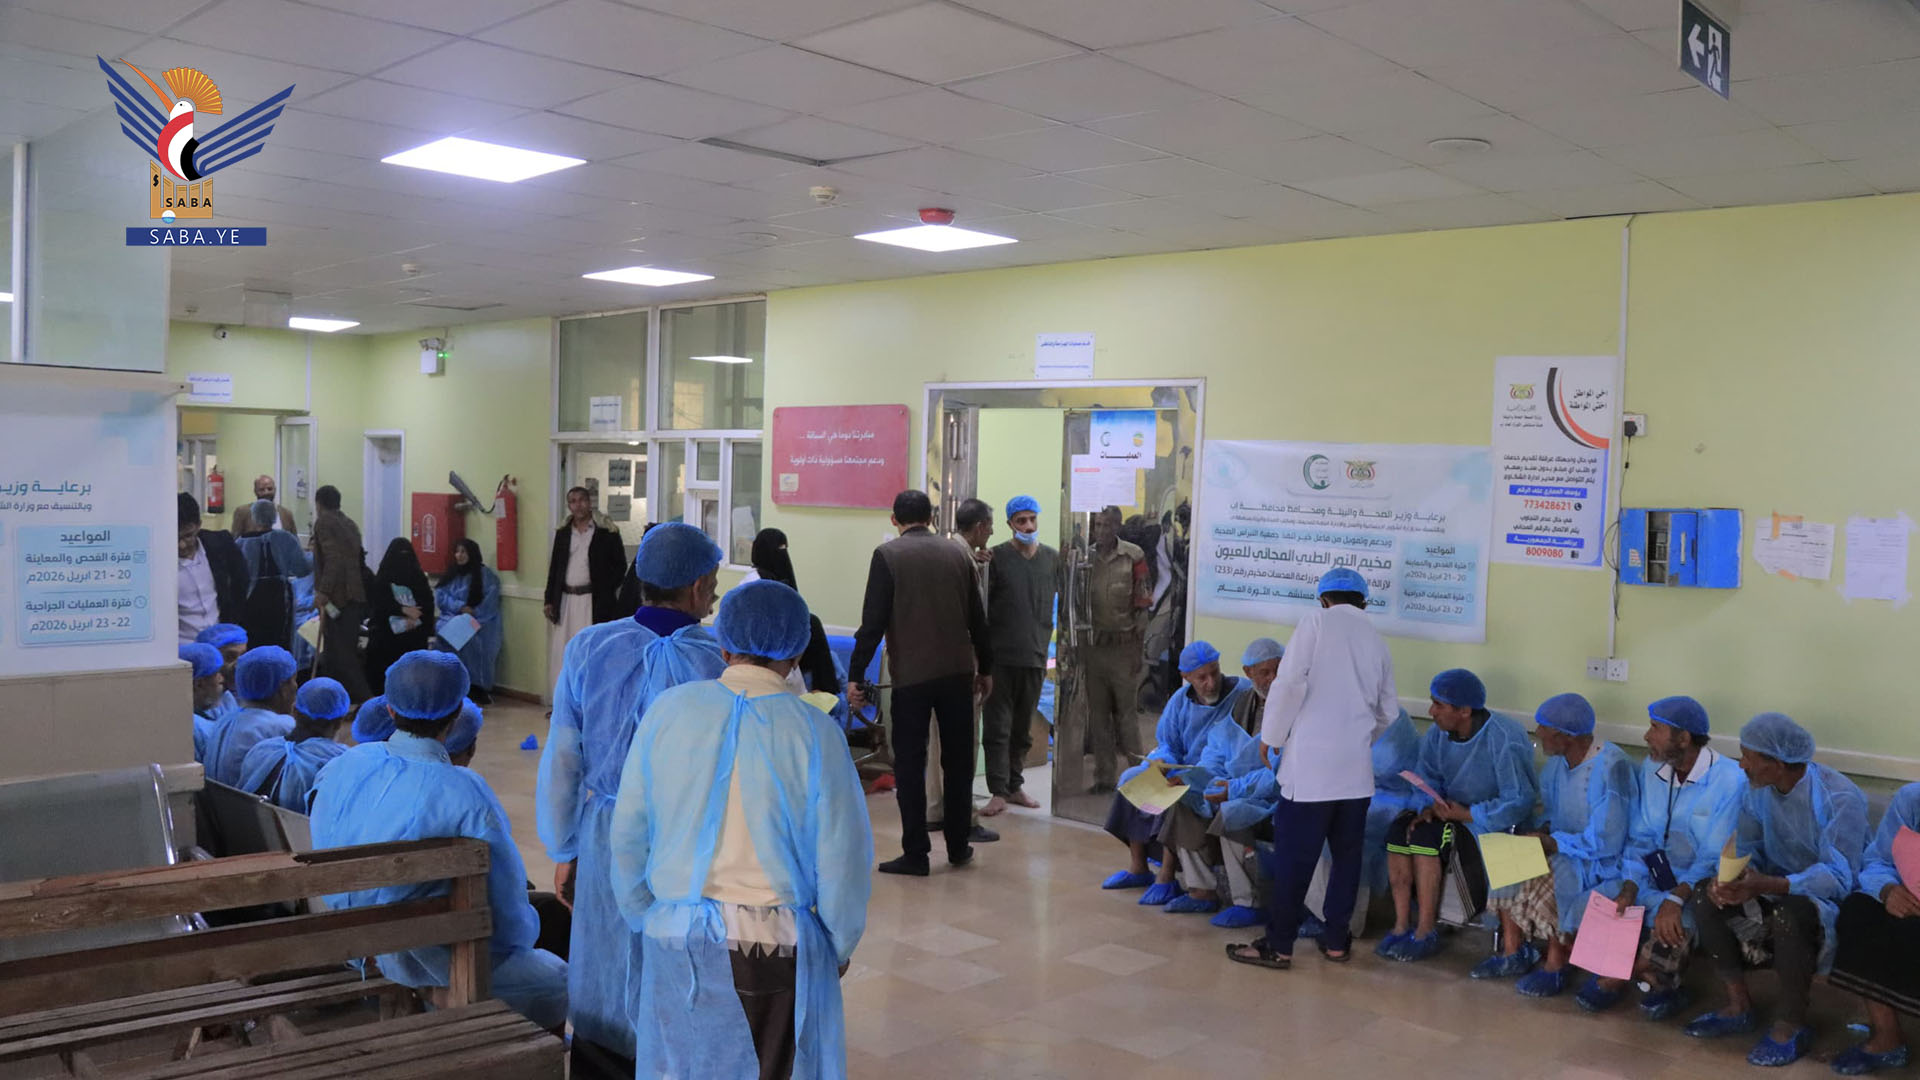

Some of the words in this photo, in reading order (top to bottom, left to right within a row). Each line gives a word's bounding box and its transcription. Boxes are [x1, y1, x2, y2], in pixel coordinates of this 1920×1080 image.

[1523, 499, 1571, 511] 773428621
[60, 530, 111, 545] المواعيد
[25, 552, 73, 566] والمعاينة
[75, 551, 108, 565] الفحص
[110, 551, 132, 564] فترة
[1214, 544, 1252, 561] للعيون
[1252, 547, 1295, 564] المجاني
[1526, 546, 1563, 558] 8009080
[1295, 551, 1331, 568] الطبي
[1357, 555, 1392, 572] مخيم
[94, 570, 107, 580] 21
[117, 569, 132, 580] 20
[25, 599, 66, 613] الجراحية
[67, 598, 109, 611] العمليات
[111, 598, 132, 610] فترة
